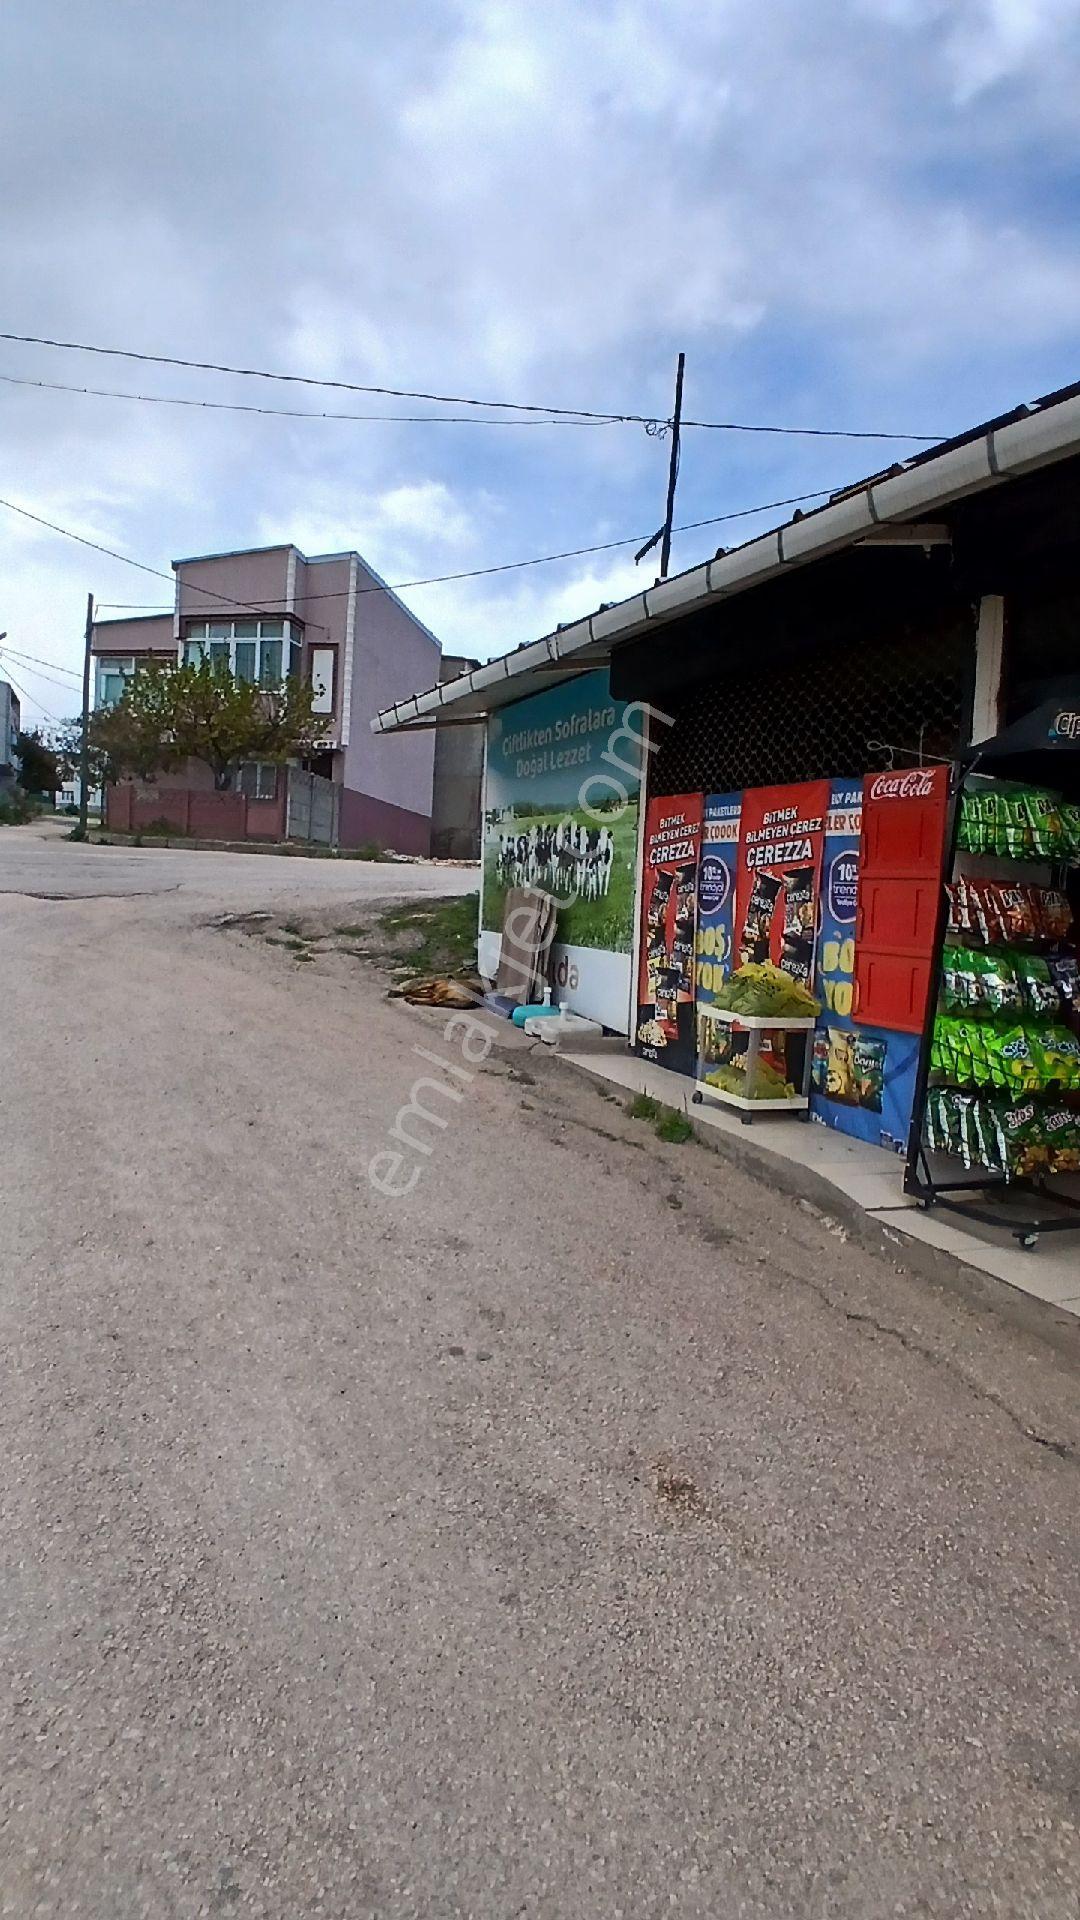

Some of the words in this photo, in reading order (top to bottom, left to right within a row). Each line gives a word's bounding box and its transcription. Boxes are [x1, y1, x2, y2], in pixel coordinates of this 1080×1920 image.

[502, 726, 552, 757] Çiftlikten
[554, 706, 616, 741] Sofralara
[516, 754, 548, 778] Doğal
[550, 741, 592, 770] Lezzet
[649, 839, 695, 869] ÇEREZZA
[746, 838, 813, 872] ÇEREZZA
